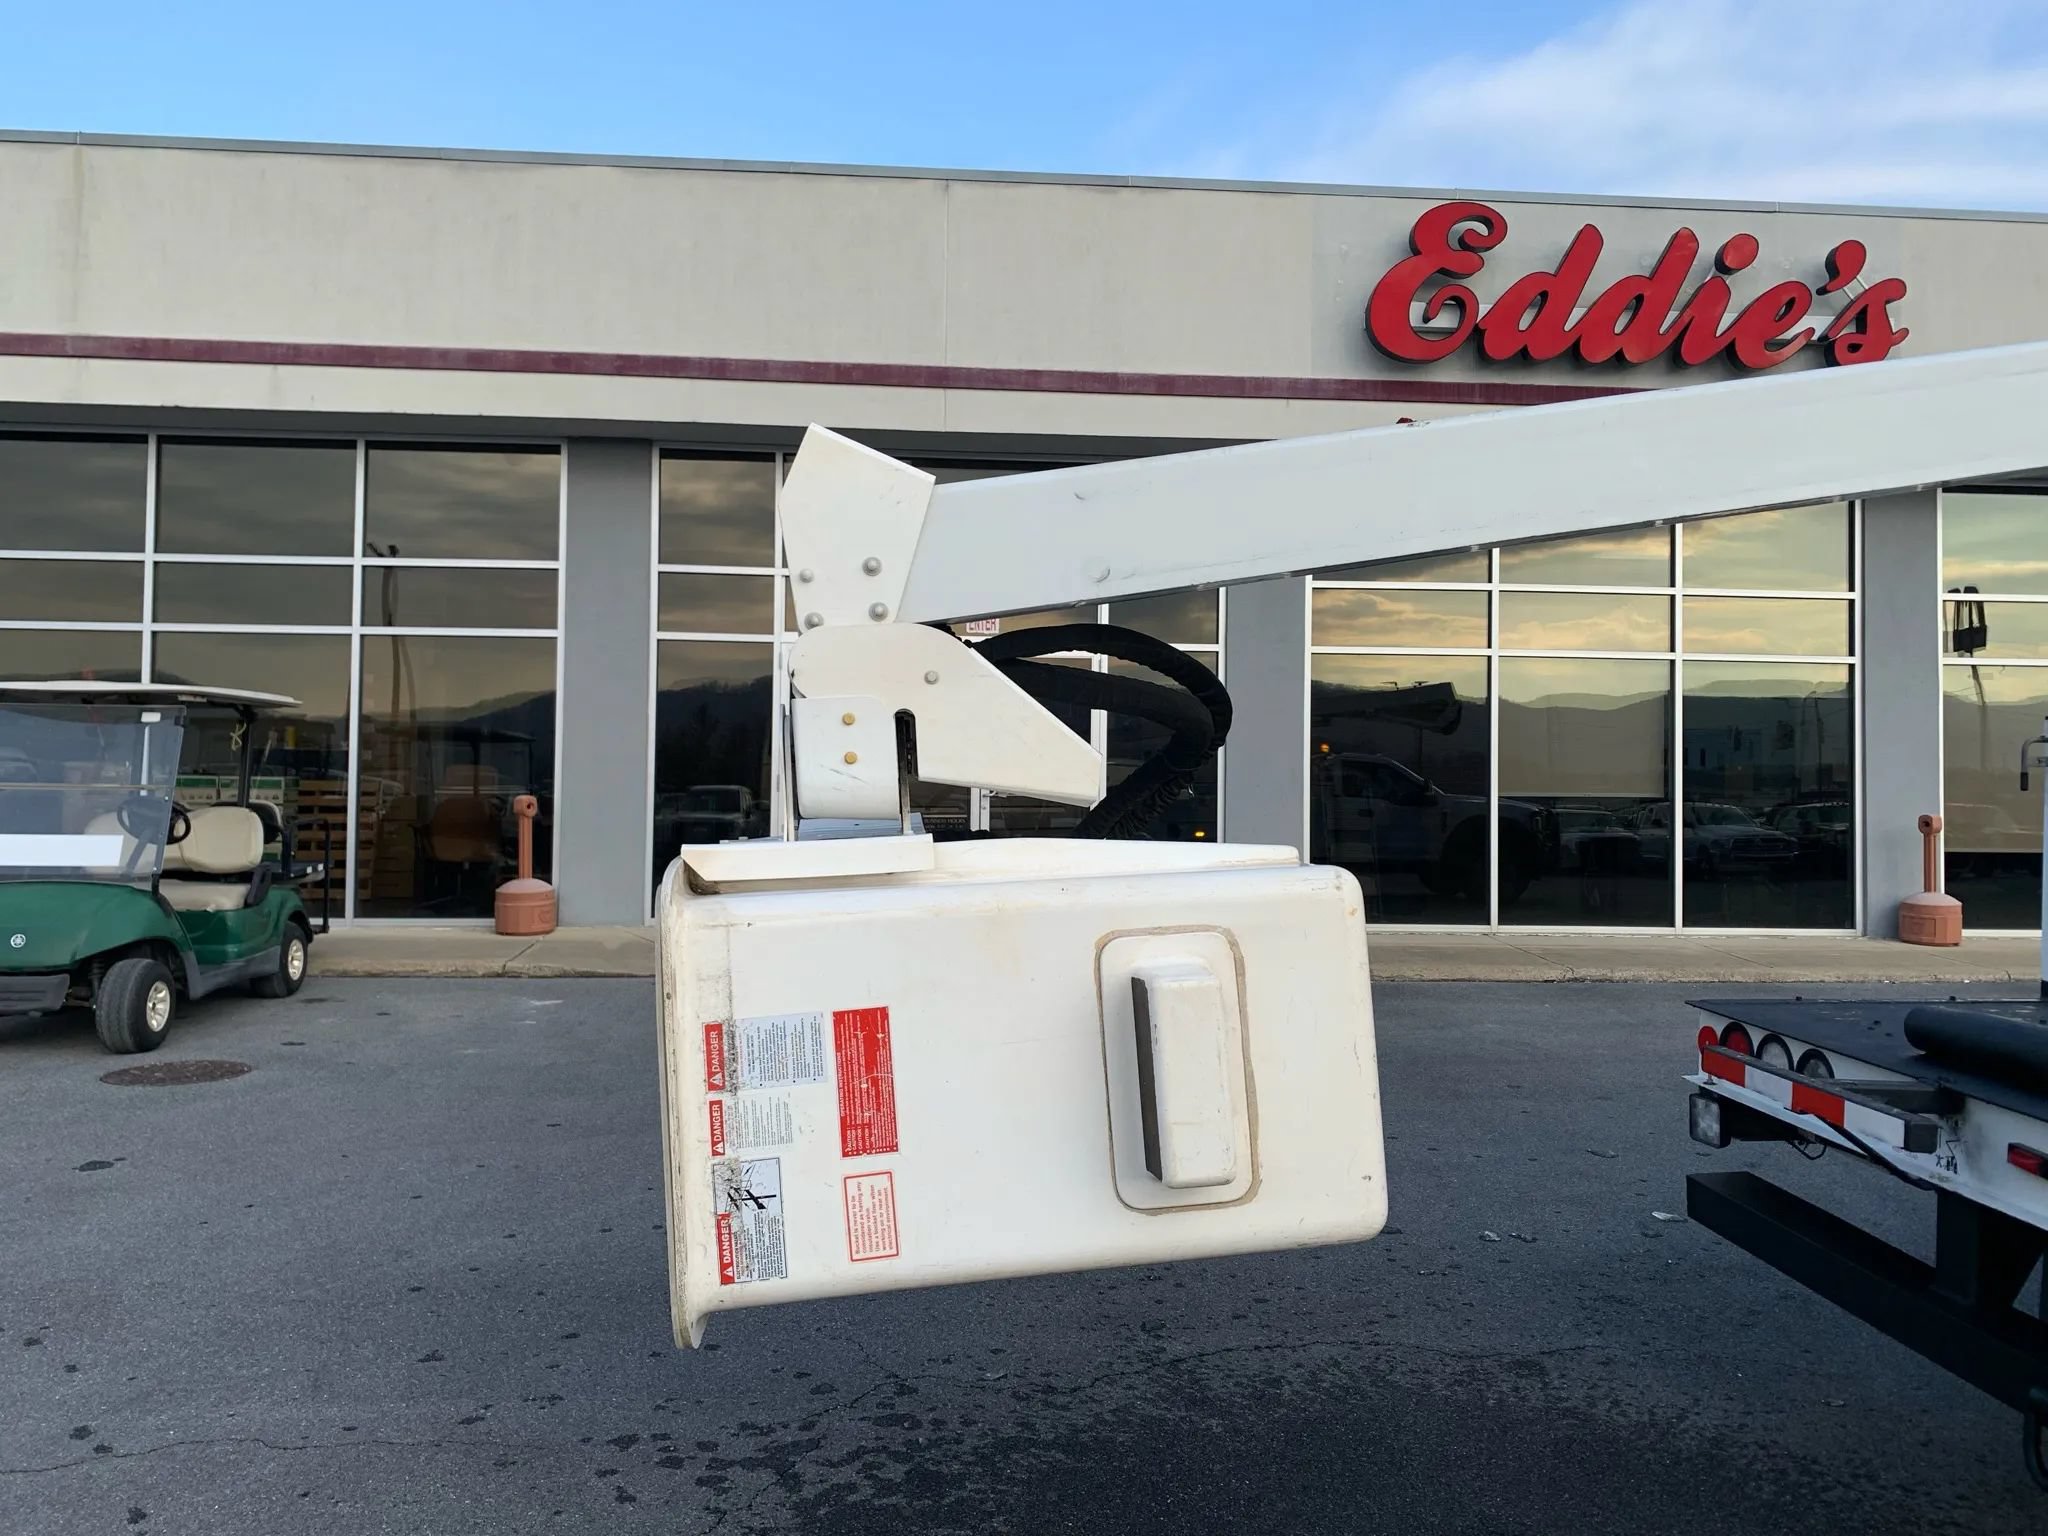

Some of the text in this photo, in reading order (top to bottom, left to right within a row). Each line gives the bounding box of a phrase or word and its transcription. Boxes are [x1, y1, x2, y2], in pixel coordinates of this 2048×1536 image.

[1366, 201, 1909, 369] Eddie's
[710, 1031, 720, 1071] DANGER
[712, 1104, 721, 1141] DANGER
[720, 1219, 731, 1264] DANGER
